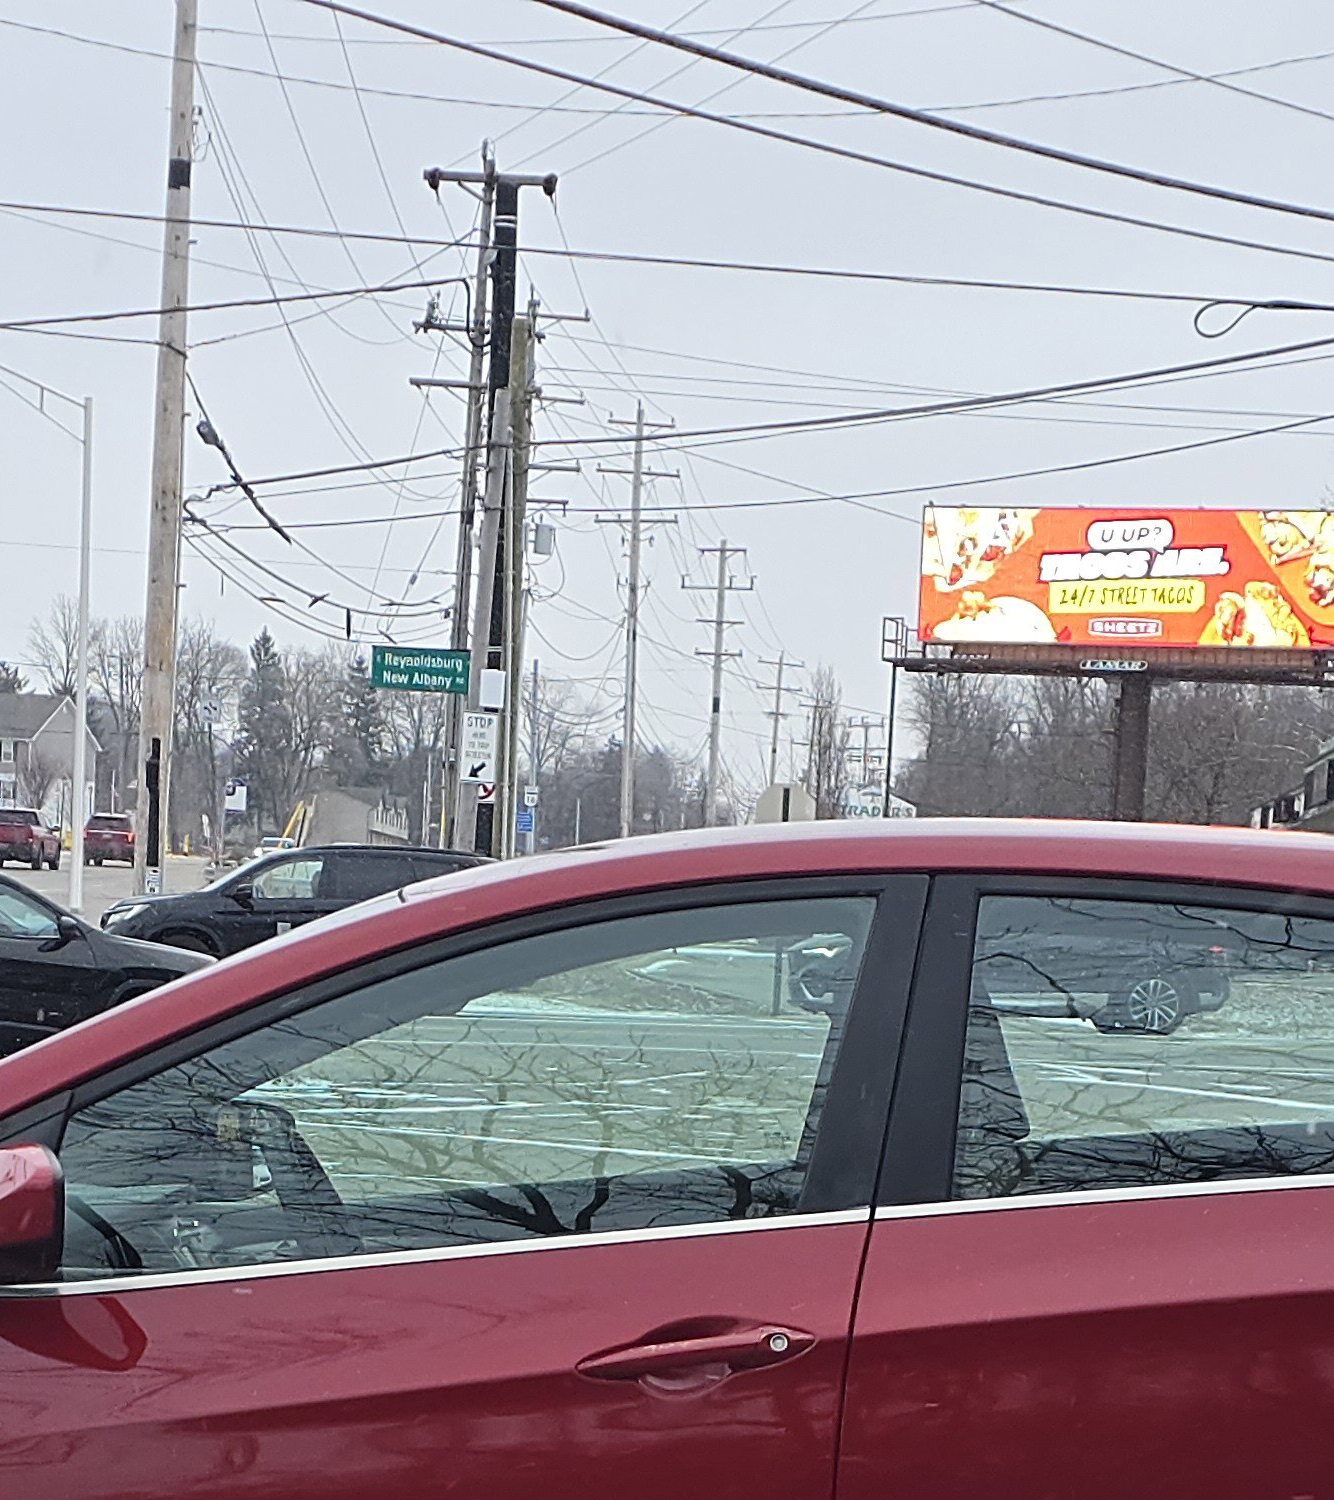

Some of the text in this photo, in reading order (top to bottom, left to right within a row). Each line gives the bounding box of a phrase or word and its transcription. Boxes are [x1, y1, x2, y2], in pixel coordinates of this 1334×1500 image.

[1100, 526, 1162, 543] U UP?
[1059, 584, 1195, 607] 24/7 STREET TACOS
[384, 652, 463, 673] Reynoldsburg
[382, 670, 410, 684] New
[412, 671, 453, 690] Albany
[467, 716, 494, 729] STOP
[839, 804, 914, 818] TRADRS
